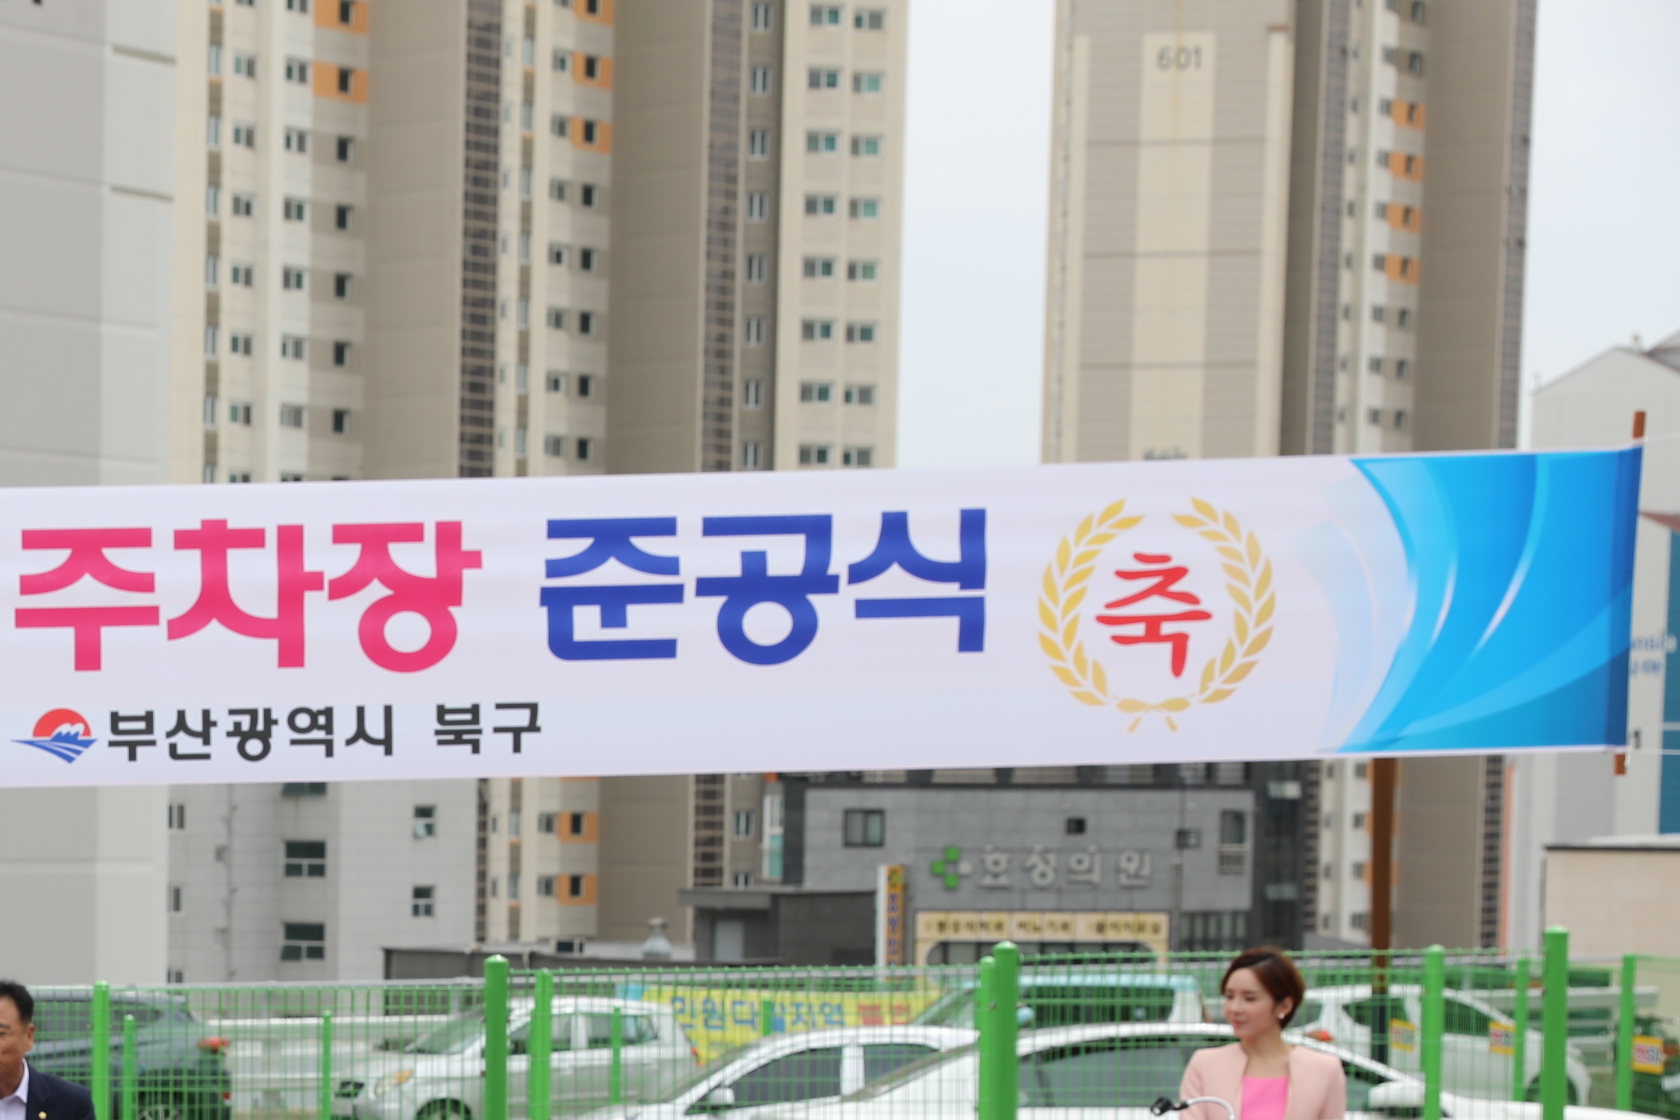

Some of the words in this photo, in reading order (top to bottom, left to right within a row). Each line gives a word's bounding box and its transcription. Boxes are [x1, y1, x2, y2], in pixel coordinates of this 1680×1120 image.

[1155, 44, 1202, 71] 601
[539, 508, 988, 666] 준공식
[1095, 552, 1213, 678] 축
[108, 704, 393, 762] 부산광역시
[434, 702, 541, 754] 북구
